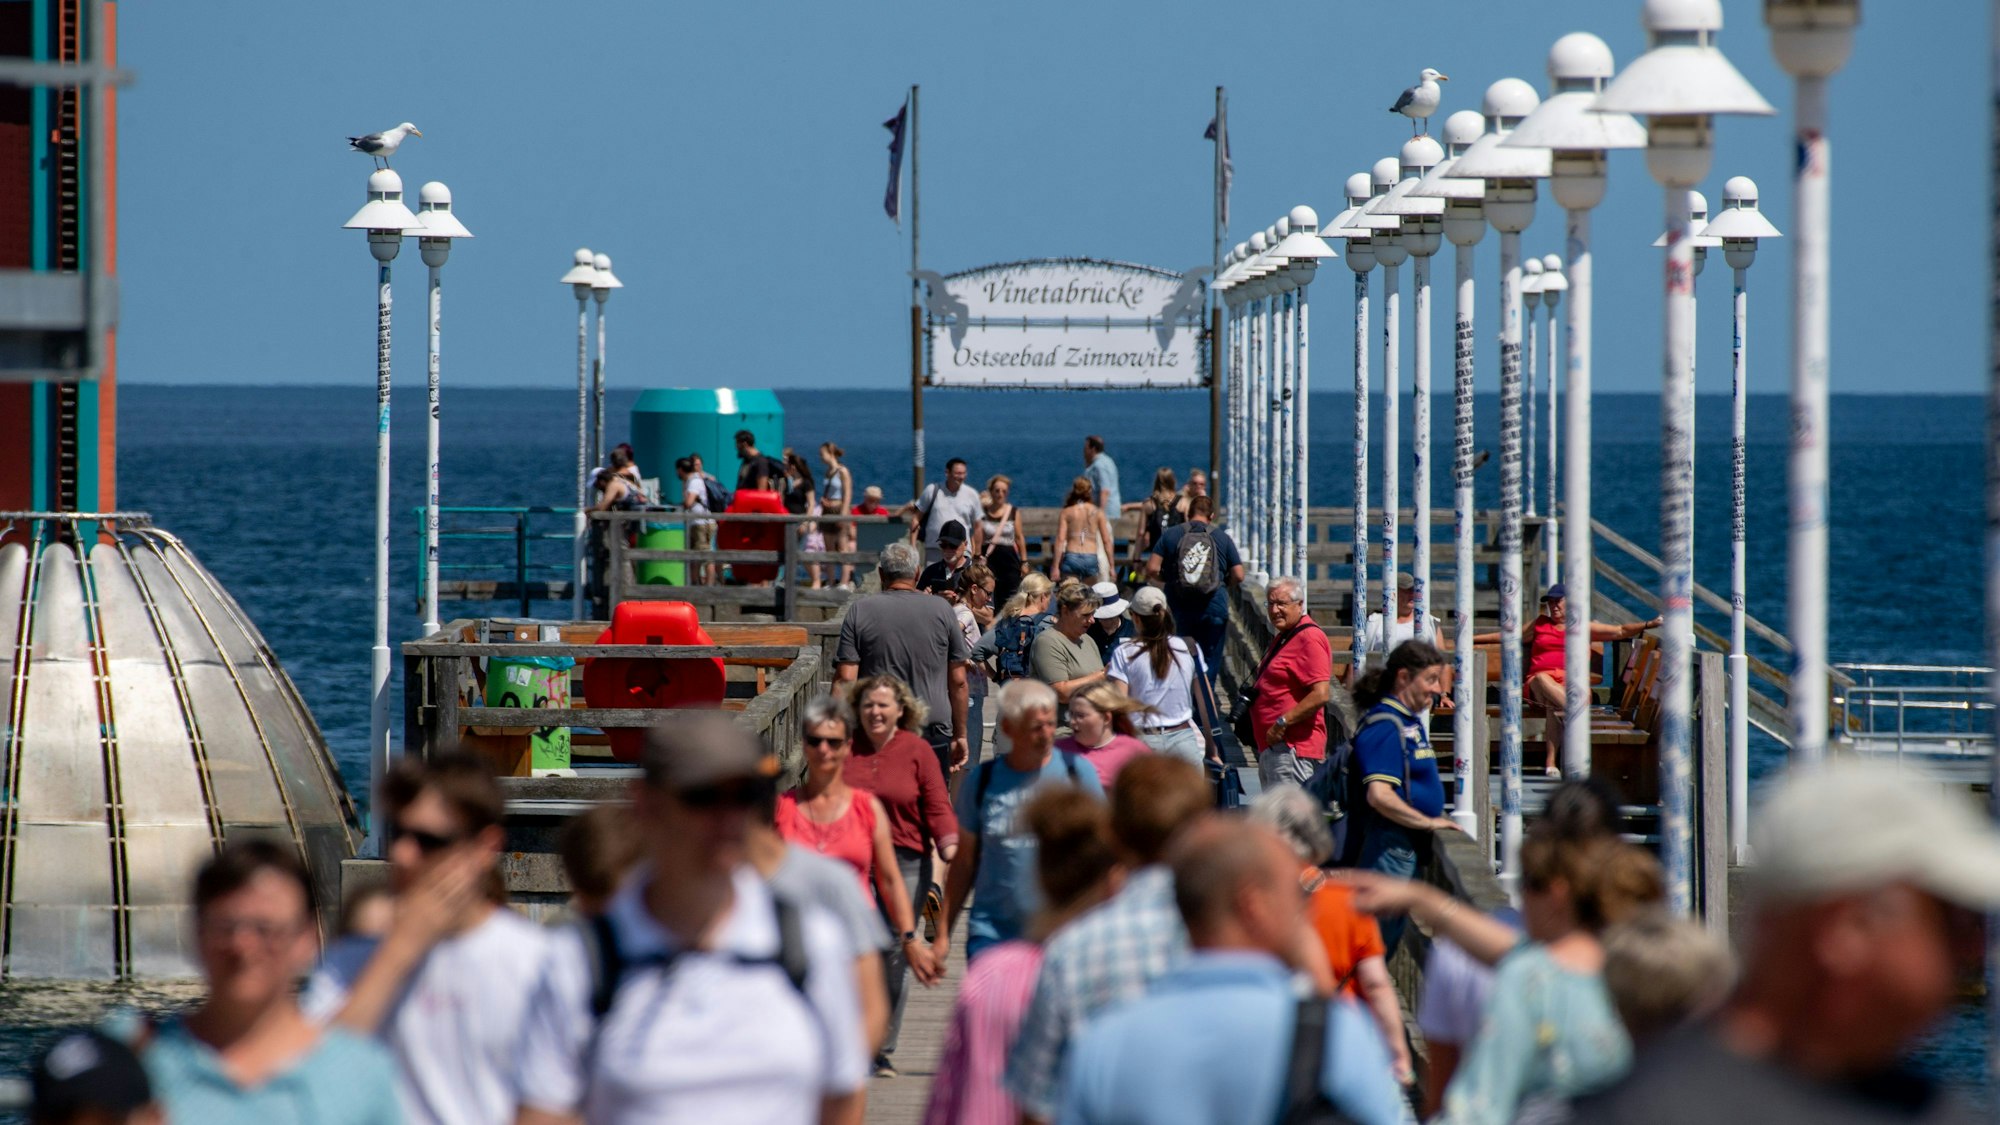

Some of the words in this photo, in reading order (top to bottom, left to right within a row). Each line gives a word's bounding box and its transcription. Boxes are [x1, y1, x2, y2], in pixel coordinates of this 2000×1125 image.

[983, 275, 1144, 310] Vinetabrücke
[953, 344, 1059, 367] Ostseebad
[1064, 347, 1179, 374] Zinnowitz
